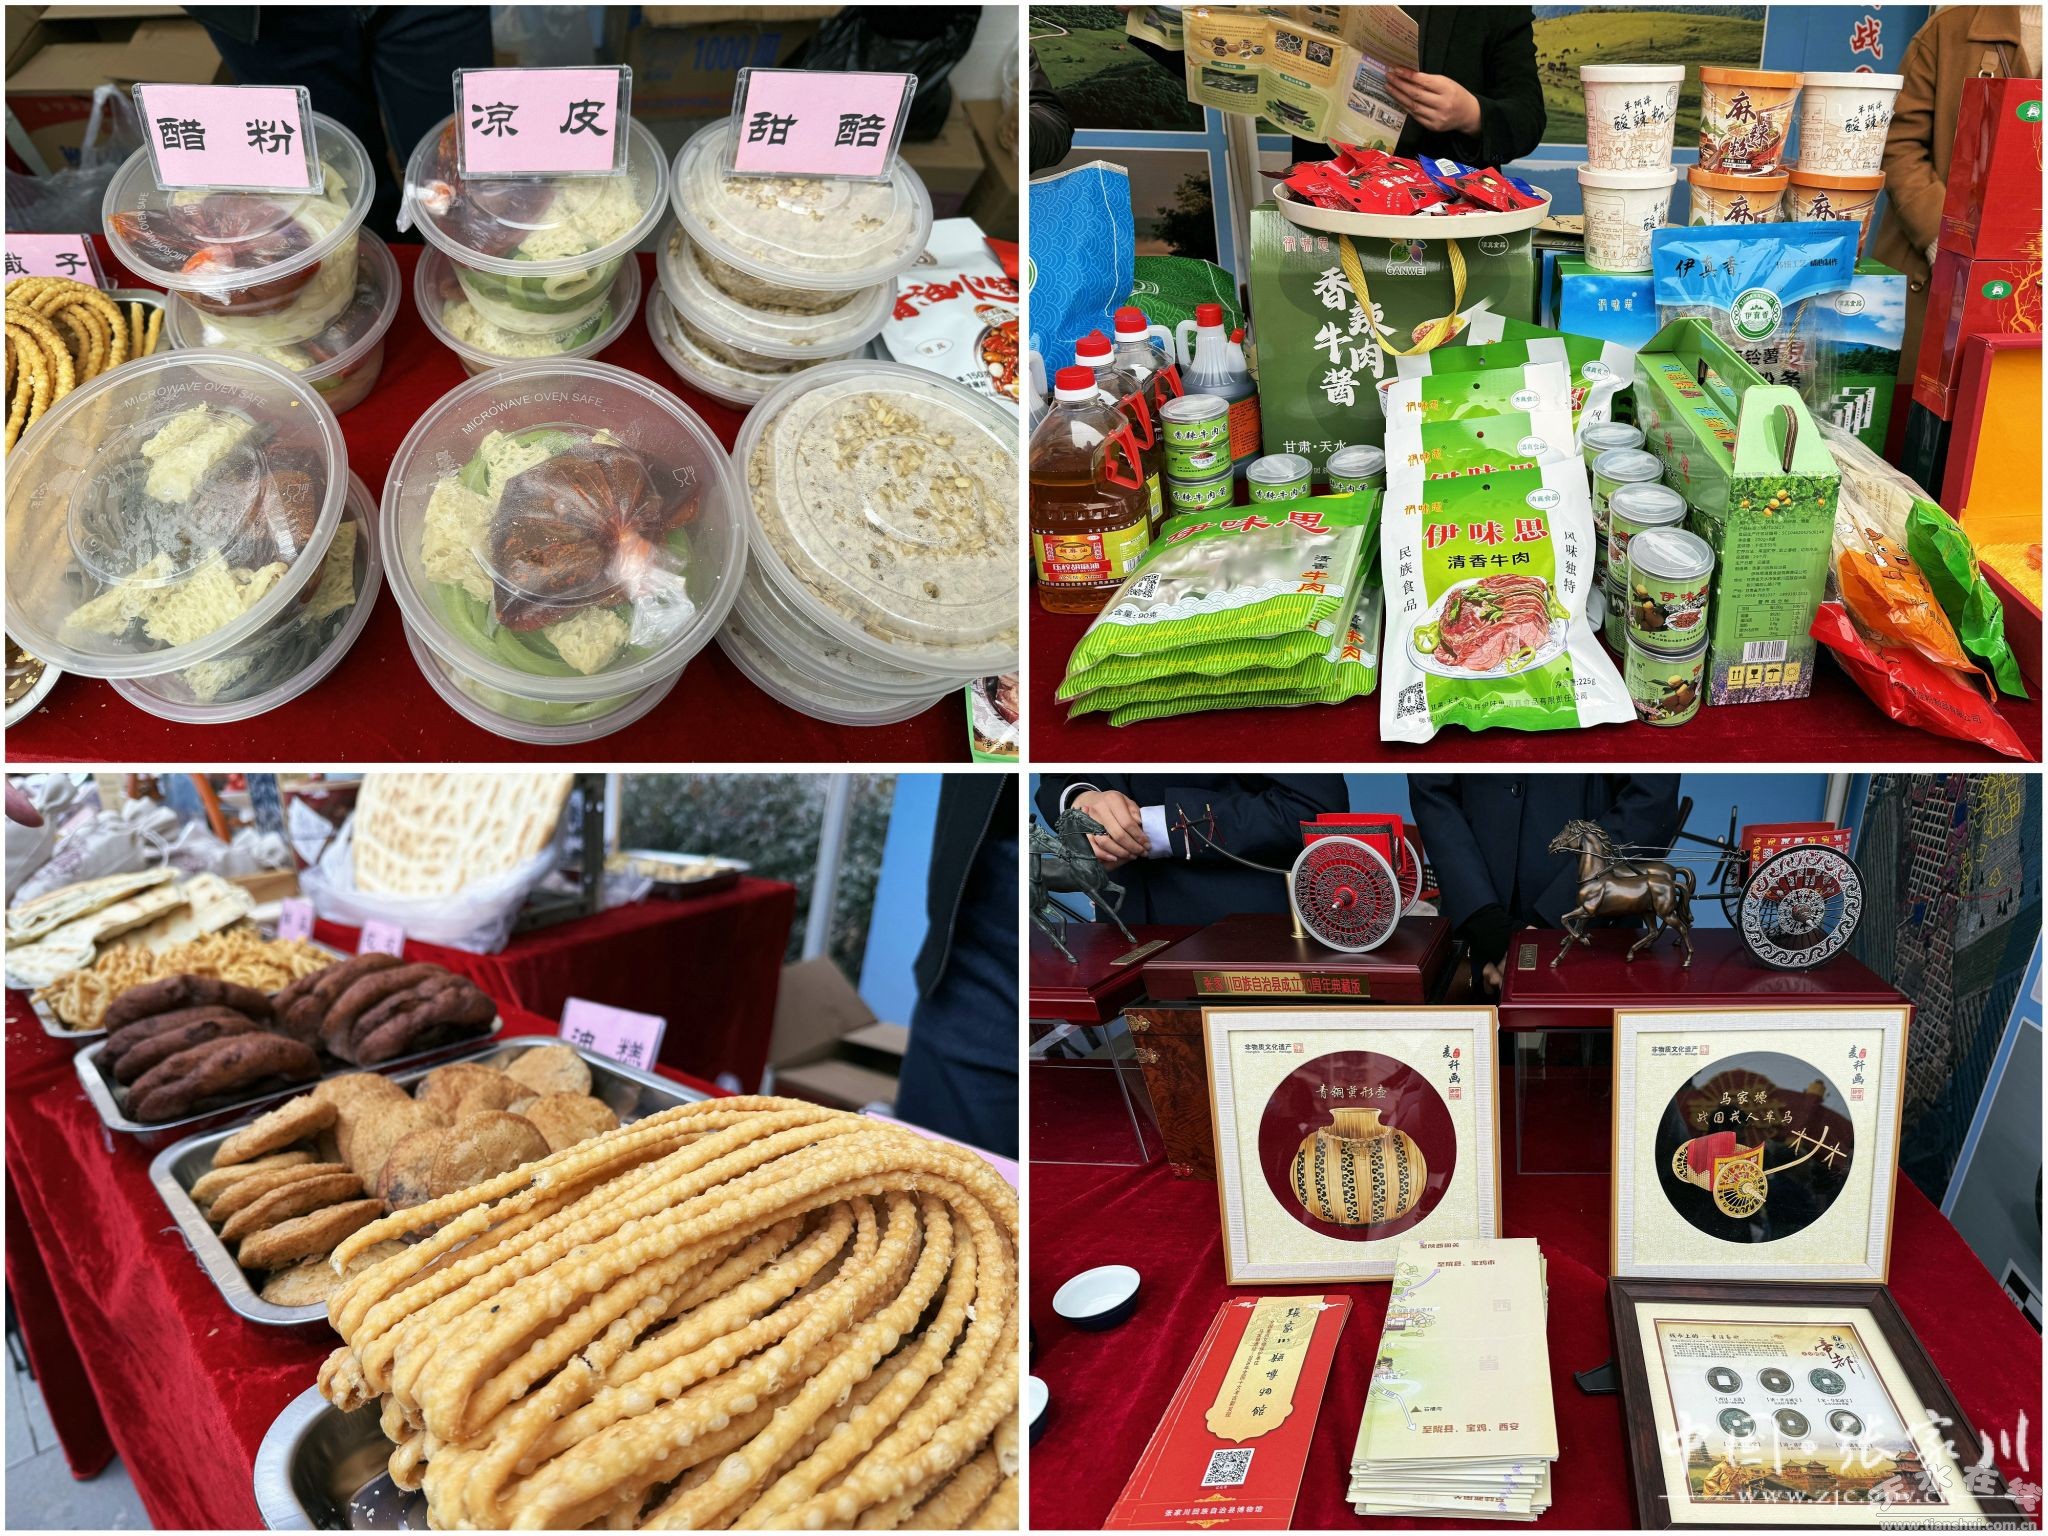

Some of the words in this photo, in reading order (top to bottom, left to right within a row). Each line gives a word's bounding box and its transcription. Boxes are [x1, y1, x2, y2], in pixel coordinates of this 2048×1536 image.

[471, 98, 608, 137] 凉皮
[747, 111, 886, 148] 甜醅
[1614, 105, 1677, 131] 酸辣粉
[156, 116, 296, 155] 醋粉
[1724, 194, 1753, 223] 麻
[1807, 191, 1836, 221] 麻
[1386, 266, 1427, 276] GANWEI
[1676, 255, 1738, 279] 伊真香
[1312, 265, 1398, 407] 香辣牛肉酱
[124, 381, 202, 409] MICROWAVE
[204, 381, 236, 397] OVEN
[237, 387, 267, 409] SAFE
[462, 392, 531, 436] MICROWAVE
[534, 390, 569, 404] OVEN
[572, 391, 604, 408] SAFE
[1282, 440, 1347, 454] 甘肃·天水
[1166, 511, 1332, 544] 伊味思
[1424, 517, 1549, 550] 伊味思
[1447, 552, 1531, 570] 清香牛肉
[1563, 530, 1578, 593] 风味独特
[1399, 545, 1417, 613] 民族食品
[1244, 1043, 1292, 1051] 非物质文化遗产
[1421, 1421, 1520, 1434] 至陇县、宝鸡、西安
[1164, 1505, 1264, 1517] 张家川回族自治县博物馆
